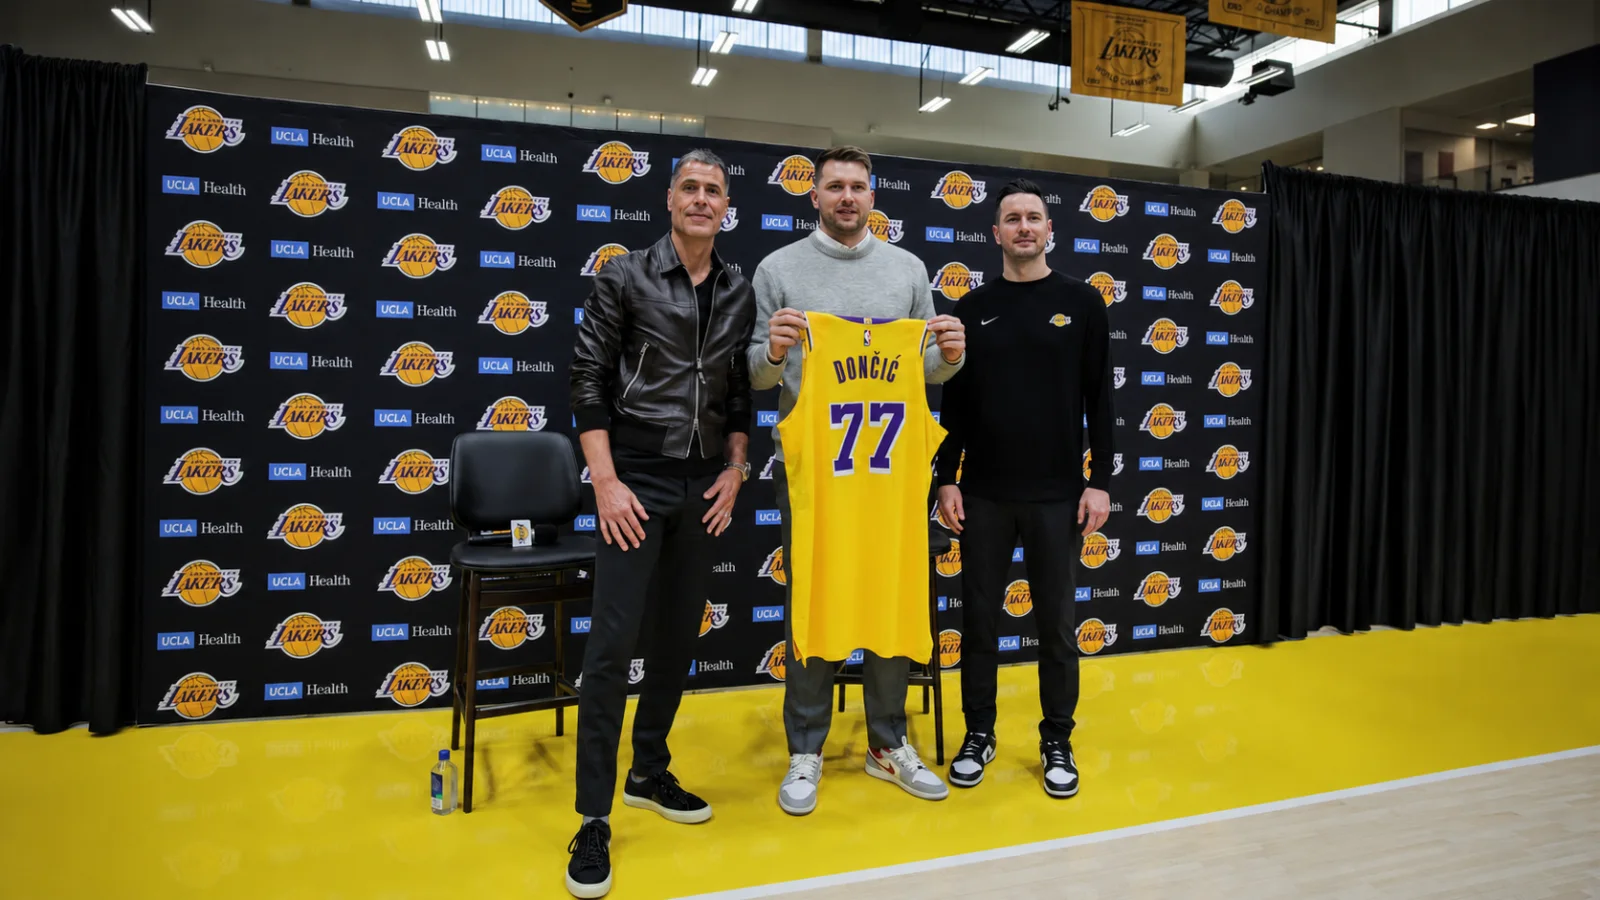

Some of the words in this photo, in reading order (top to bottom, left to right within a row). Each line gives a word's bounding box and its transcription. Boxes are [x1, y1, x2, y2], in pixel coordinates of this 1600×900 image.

[1099, 36, 1161, 68] LAKERS
[172, 116, 240, 144] LAKERS
[276, 130, 304, 143] UCLA
[312, 132, 354, 148] Health
[387, 135, 452, 162] LAKERS
[486, 147, 512, 159] UCLA
[520, 149, 558, 164] Health
[588, 151, 646, 176] LAKERS
[772, 164, 816, 182] LAKER
[166, 179, 196, 191] UCLA
[204, 180, 246, 196] Health
[878, 177, 911, 191] Health
[935, 179, 983, 202] LAKERS
[277, 181, 343, 208] LAKERS
[1044, 193, 1061, 204] alth
[382, 196, 410, 207] UCLA
[418, 197, 458, 211] Health
[486, 196, 547, 221] LAKERS
[1083, 194, 1126, 215] LAKERS
[1148, 204, 1166, 214] UCLA
[1170, 205, 1196, 217] Health
[582, 208, 606, 219] UCLA
[614, 209, 650, 222] Health
[1216, 207, 1254, 227] LAKERS
[766, 217, 788, 228] UCLA
[796, 219, 820, 230] Heal
[928, 230, 950, 240] UCLA
[956, 230, 986, 243] Health
[172, 232, 239, 258] LAKERS
[276, 244, 304, 255] UCLA
[312, 244, 354, 259] Health
[1078, 241, 1096, 251] UCLA
[1102, 242, 1128, 254] Health
[1146, 242, 1188, 263] LAKERS
[387, 244, 452, 270] LAKERS
[484, 254, 510, 265] UCLA
[518, 255, 556, 268] Health
[1210, 252, 1228, 261] UCLA
[1232, 252, 1256, 263] Health
[166, 295, 194, 306] UCLA
[204, 295, 246, 310] Health
[1146, 288, 1164, 298] UCLA
[1168, 289, 1194, 301] Health
[1214, 289, 1251, 308] LAKERS
[276, 294, 342, 319] LAKERS
[382, 304, 408, 315] UCLA
[418, 304, 456, 317] Health
[483, 301, 544, 326] LAKERS
[1145, 327, 1186, 346] LAKERS
[1208, 334, 1226, 343] UCLA
[1230, 333, 1254, 344] Health
[171, 346, 239, 372] LAKERS
[274, 355, 304, 366] UCLA
[312, 355, 352, 368] Health
[386, 353, 451, 377] LAKERS
[482, 360, 508, 371] UCLA
[516, 360, 554, 373] Health
[833, 351, 901, 384] DONČIĆ
[1144, 374, 1162, 383] UCLA
[1166, 373, 1192, 384] Health
[1212, 371, 1249, 390] LAKERS
[166, 409, 194, 420] UCLA
[202, 409, 244, 422] Health
[275, 406, 341, 430] LAKERS
[380, 413, 408, 423] UCLA
[416, 412, 454, 425] Health
[482, 408, 543, 430] LAKERS
[760, 414, 778, 423] UCL
[1143, 413, 1184, 431] LAKERS
[1206, 417, 1224, 426] UCLA
[1228, 416, 1252, 426] Health
[829, 402, 905, 476] 77
[1142, 459, 1160, 468] UCLA
[1164, 458, 1190, 469] Health
[1210, 454, 1247, 472] LAKERS
[170, 460, 238, 484] LAKERS
[274, 466, 302, 477] UCLA
[310, 465, 352, 478] Health
[384, 461, 448, 484] LAKERS
[1140, 497, 1182, 516] LAKERS
[1204, 499, 1222, 508] UCLA
[1226, 497, 1248, 508] Health
[164, 523, 192, 534] UCLA
[202, 522, 242, 534] Health
[274, 516, 340, 539] LAKERS
[378, 521, 406, 531] UCLA
[414, 519, 454, 531] Health
[578, 518, 596, 527] UCL
[1138, 543, 1156, 552] UCLA
[1162, 541, 1186, 552] Health
[1206, 536, 1244, 553] LAKERS
[168, 574, 236, 596] LAKERS
[272, 576, 300, 587] UCLA
[310, 574, 350, 587] Health
[383, 569, 447, 590] LAKERS
[1202, 581, 1218, 590] UCLA
[1222, 578, 1246, 589] Health
[1075, 590, 1088, 598] CLA
[1093, 588, 1120, 598] Health
[1137, 582, 1178, 598] LAKERS
[756, 609, 780, 619] UCLA
[376, 627, 404, 638] UCLA
[412, 624, 452, 637] Health
[484, 619, 541, 639] LAKERS
[1136, 627, 1154, 637] UCLA
[1158, 624, 1184, 635] Health
[1204, 618, 1243, 635] LAKERS
[162, 635, 190, 647] UCLA
[198, 632, 240, 646] Health
[272, 626, 338, 648] LAKERS
[1022, 637, 1039, 647] Hea
[699, 660, 734, 672] Health
[381, 676, 445, 696] LAKERS
[512, 673, 550, 686] Health
[164, 687, 233, 707] LAKERS
[270, 686, 298, 697] UCLA
[306, 682, 348, 696] Health
